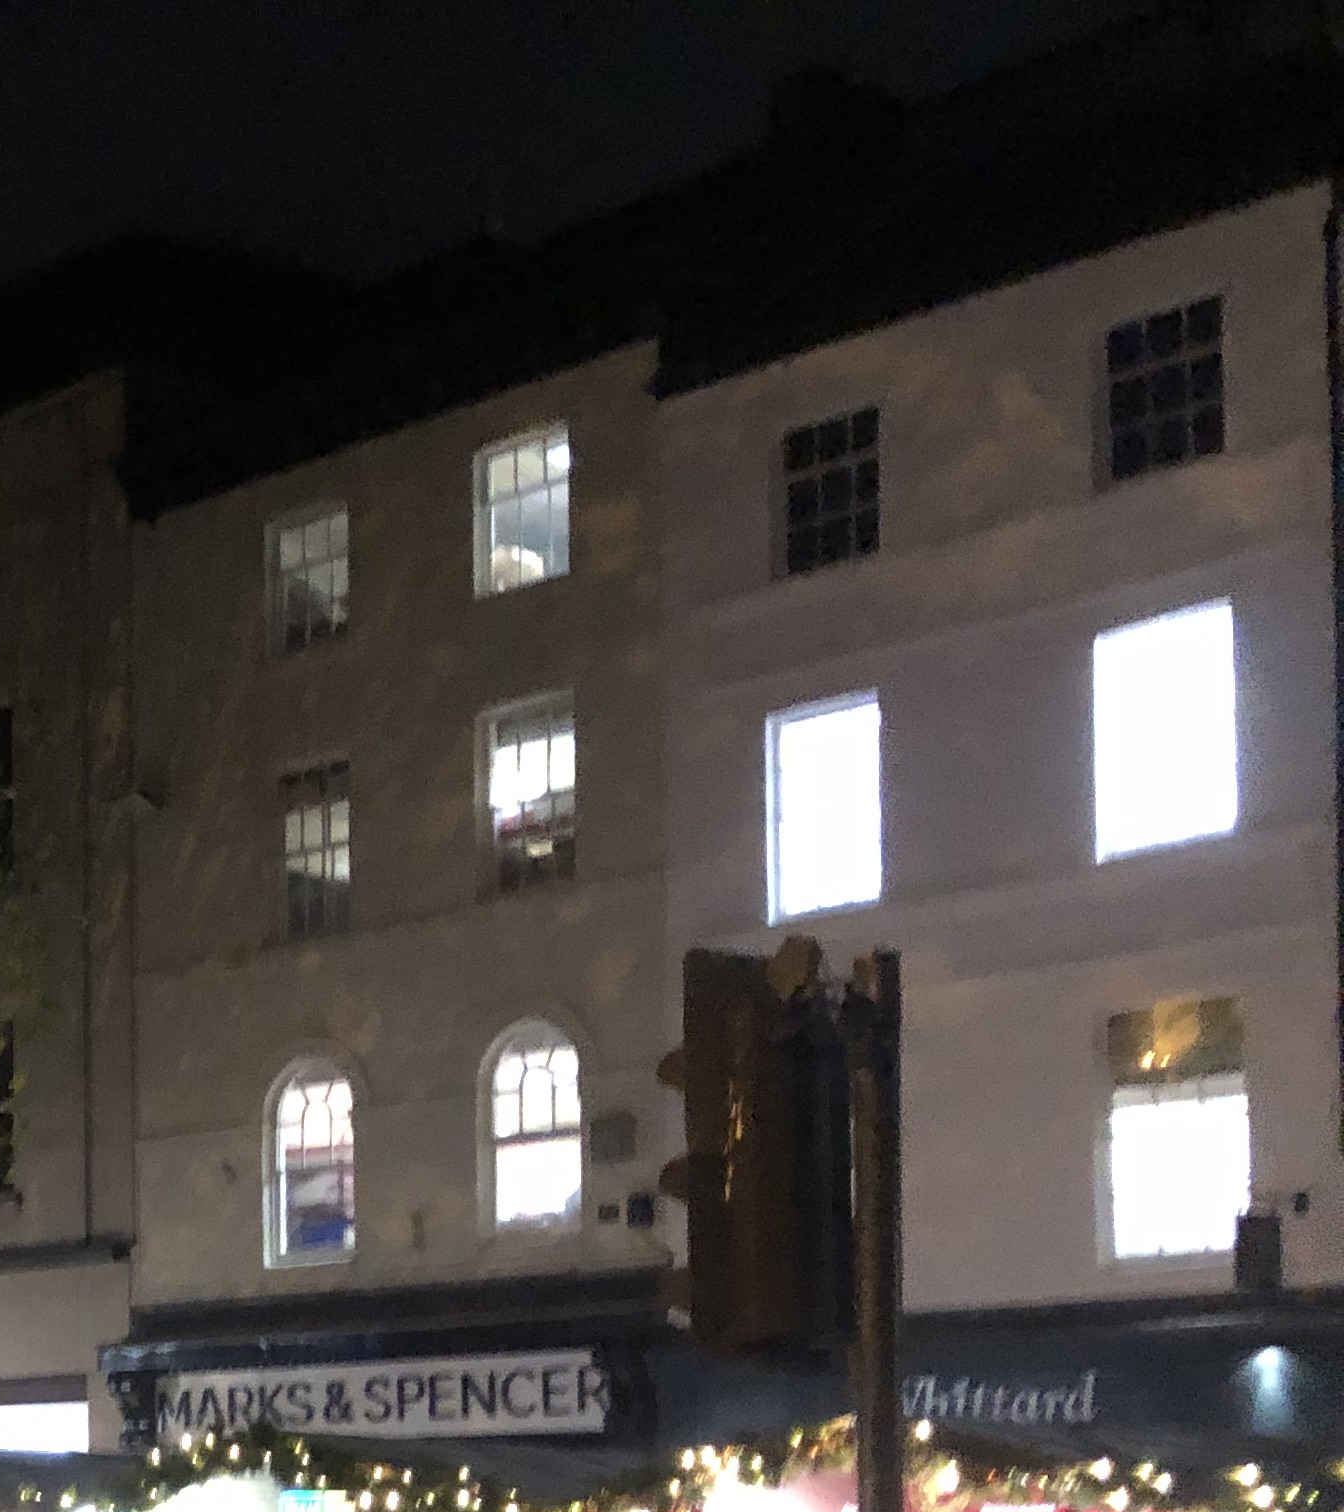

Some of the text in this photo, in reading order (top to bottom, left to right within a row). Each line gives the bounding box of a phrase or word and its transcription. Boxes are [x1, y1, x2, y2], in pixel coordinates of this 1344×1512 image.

[157, 1364, 610, 1434] MARKS & SPENCER
